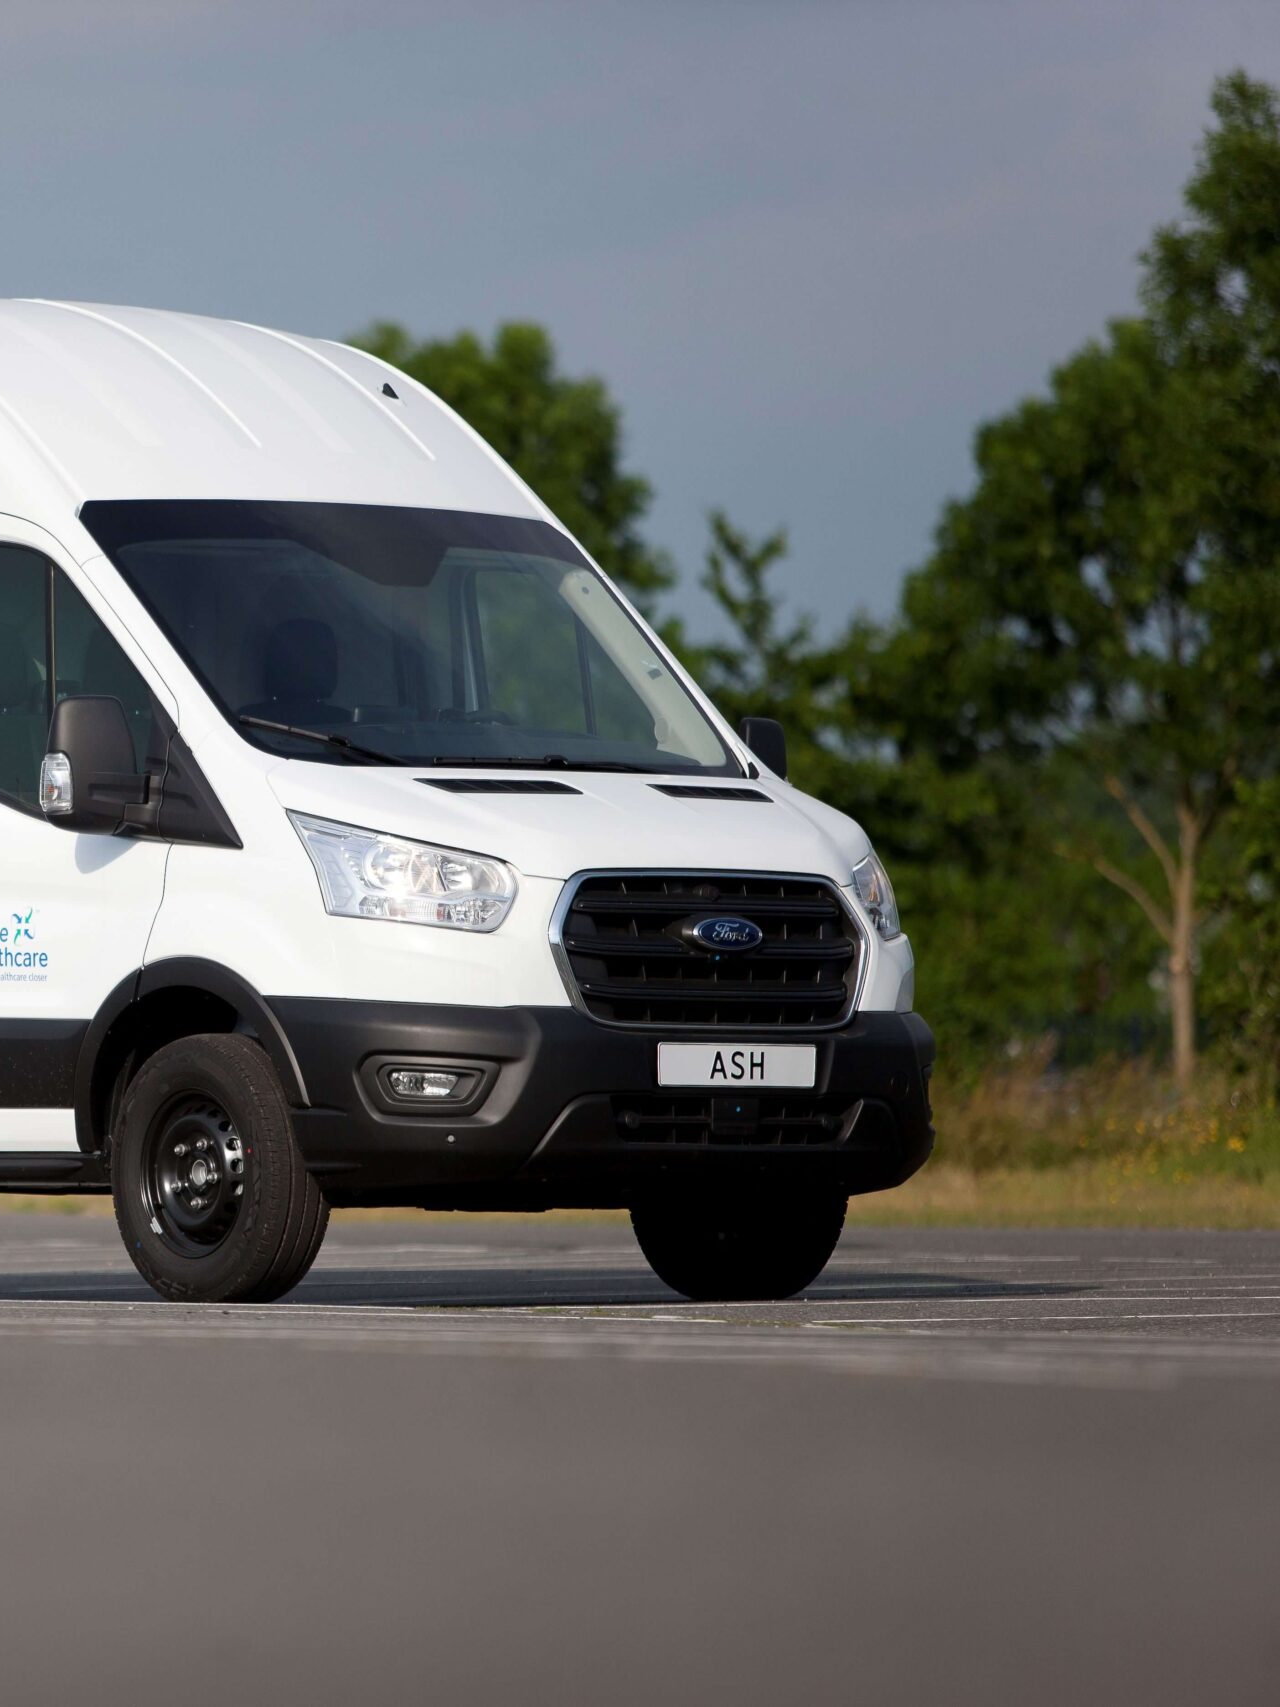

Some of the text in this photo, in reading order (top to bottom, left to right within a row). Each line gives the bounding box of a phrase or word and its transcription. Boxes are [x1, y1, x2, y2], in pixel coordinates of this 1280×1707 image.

[712, 922, 750, 942] Ford
[28, 972, 48, 982] closer
[709, 1050, 765, 1080] ASH
